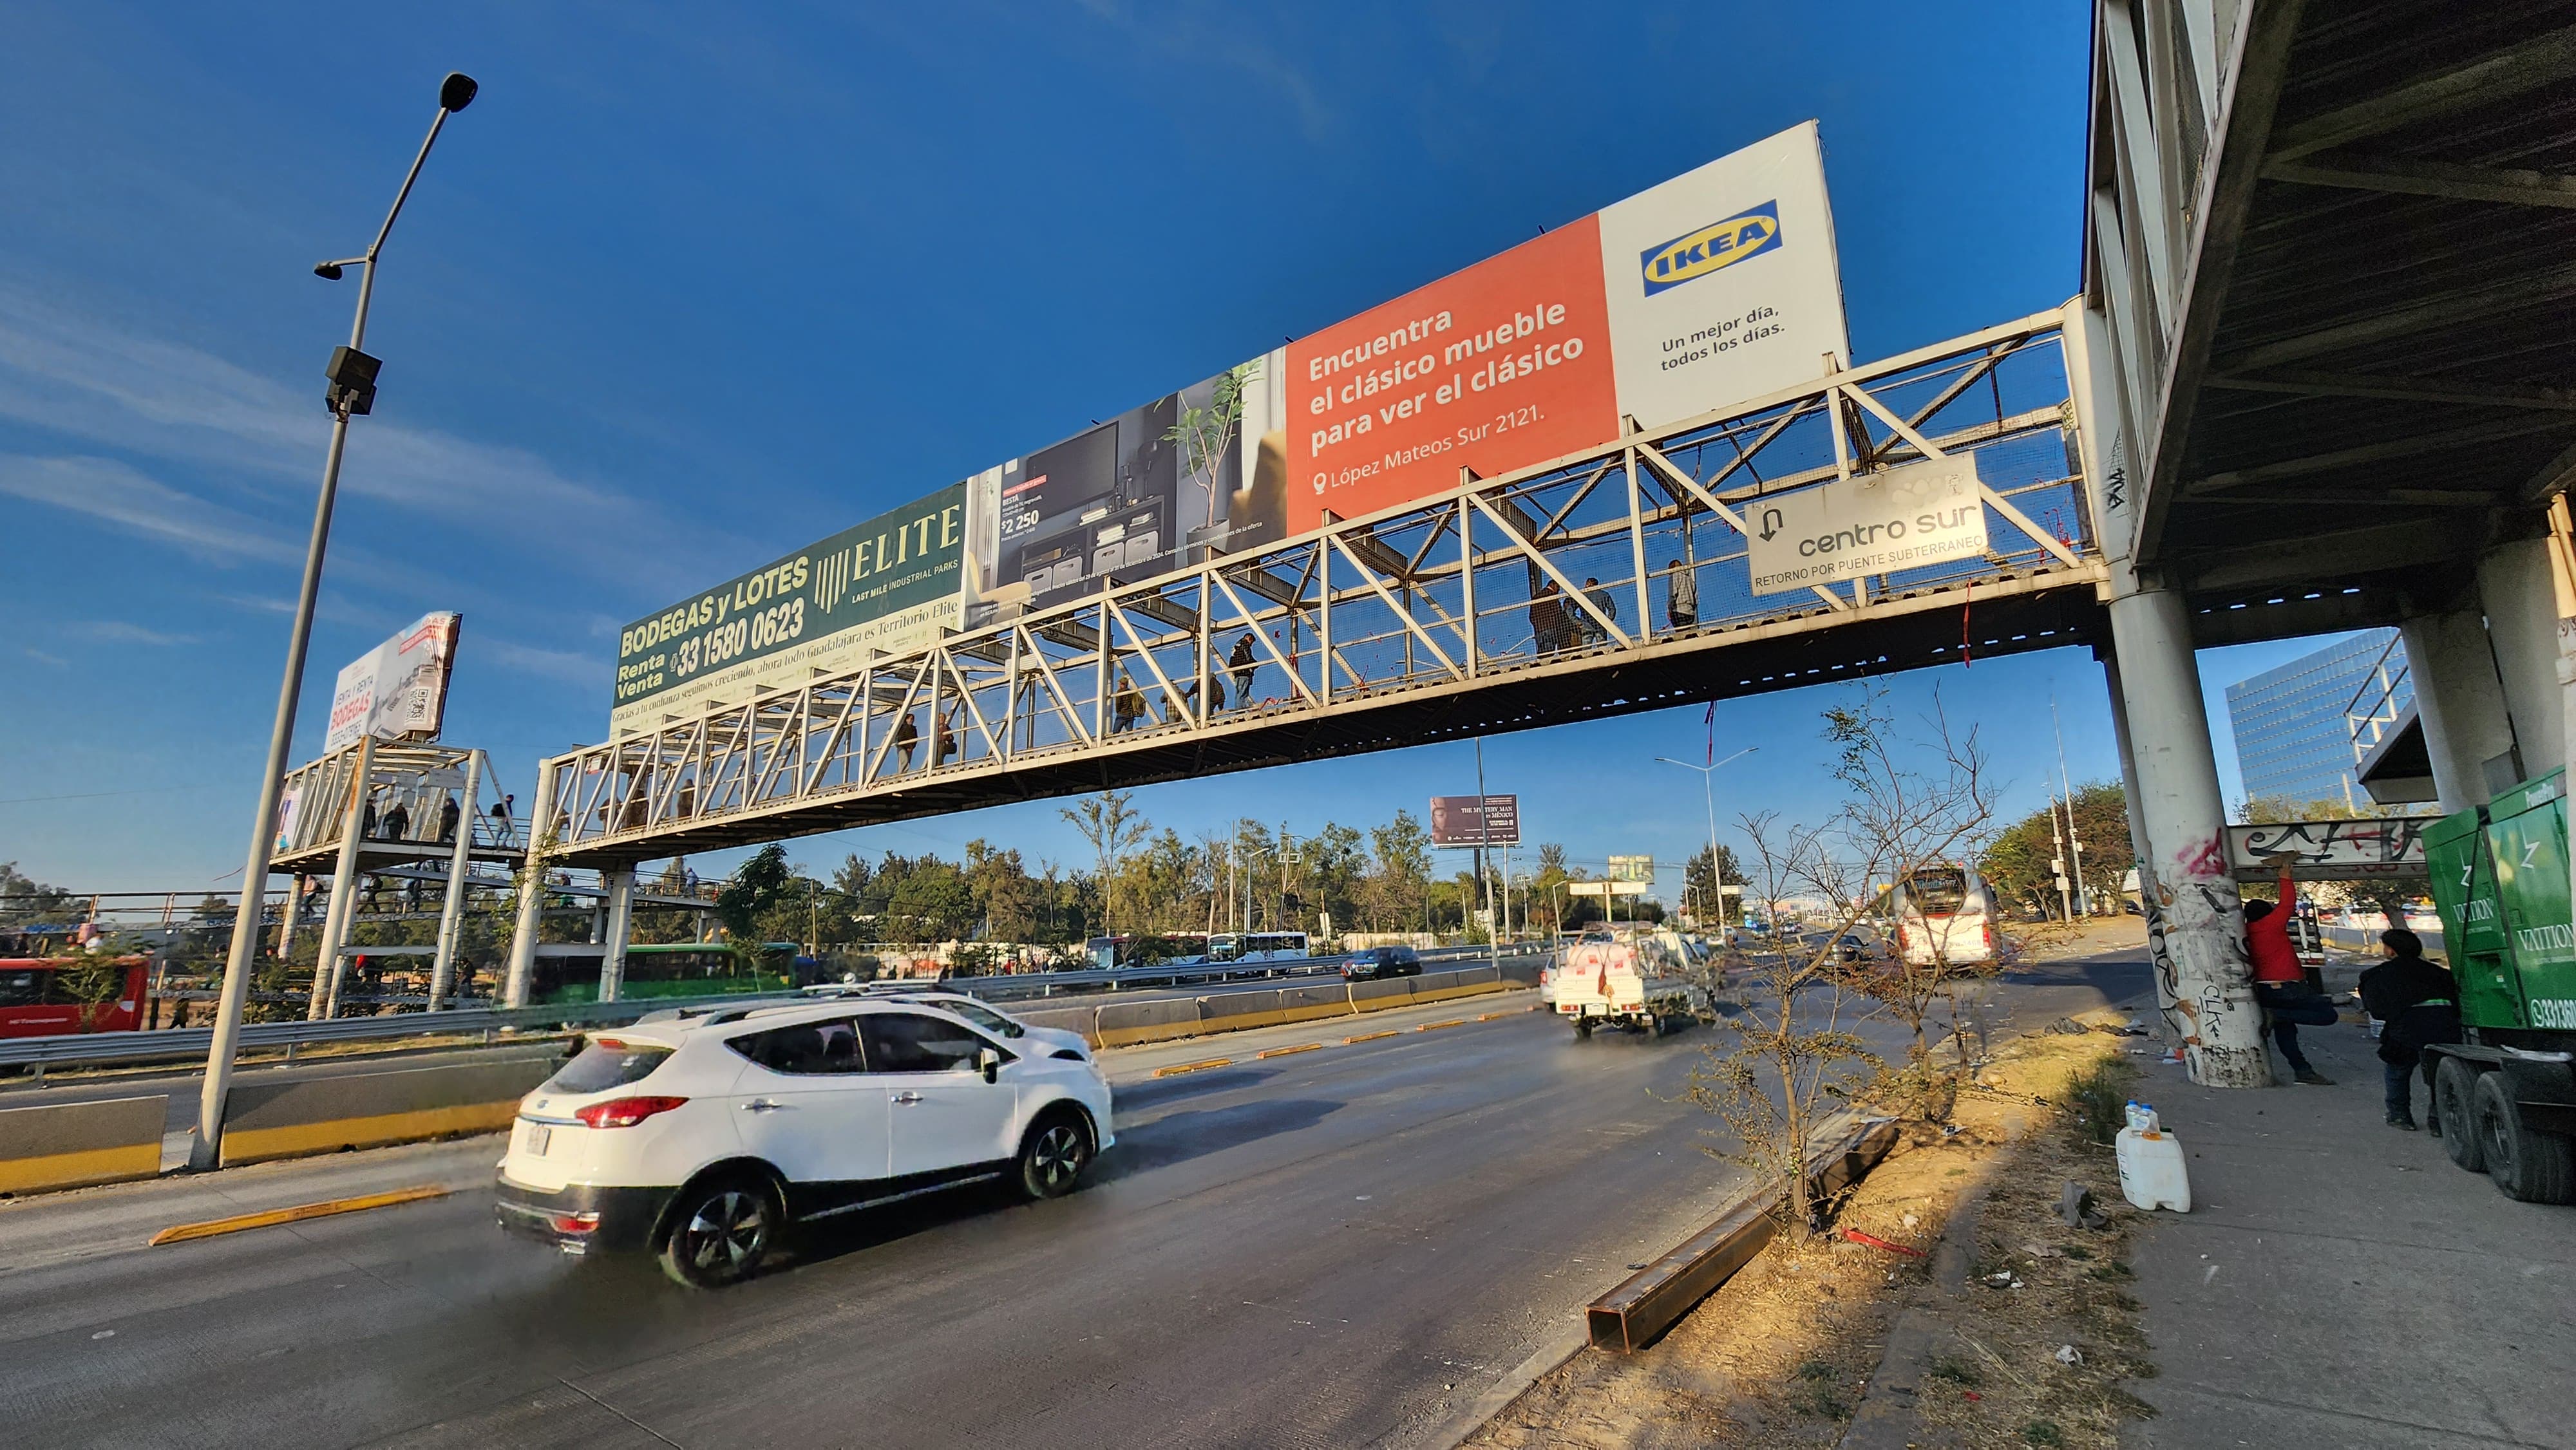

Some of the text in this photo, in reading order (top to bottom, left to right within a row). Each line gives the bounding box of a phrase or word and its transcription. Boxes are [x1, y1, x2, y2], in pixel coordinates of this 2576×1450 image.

[1656, 221, 1768, 278] IKEA
[1309, 310, 1452, 381] Encuentra
[1661, 322, 1785, 371] todos los días.
[1662, 305, 1779, 352] Un mejor día,
[1310, 303, 1566, 415] el clásico mueble
[1311, 337, 1584, 457] para ver el clásico
[1331, 404, 1545, 488] López Mateos Sur 2121.
[853, 504, 960, 581] ELITE
[1016, 509, 1039, 531] 250
[1247, 521, 1263, 531] oferta
[1799, 505, 1977, 557] centro sur
[851, 559, 958, 604] LAST MILE INDUSTRIAL PARKS
[1755, 535, 1984, 587] RETORNO POR PUENTE SUBTERRANEO
[621, 556, 809, 658] BODEGAS y LOTES
[612, 708, 634, 722] Gracias
[635, 706, 640, 716] a
[649, 692, 680, 711] confianza
[681, 681, 714, 700] seguimos
[757, 659, 782, 674] ahora
[784, 650, 804, 665] todo
[807, 632, 862, 657] Guadalajara
[864, 627, 875, 639] es
[878, 610, 929, 636] Territorio
[933, 600, 958, 619] Elite
[677, 597, 804, 677] 33 1580 0623
[617, 672, 663, 700] Venta
[618, 652, 665, 683] Renta
[330, 690, 371, 731] BODEGAS
